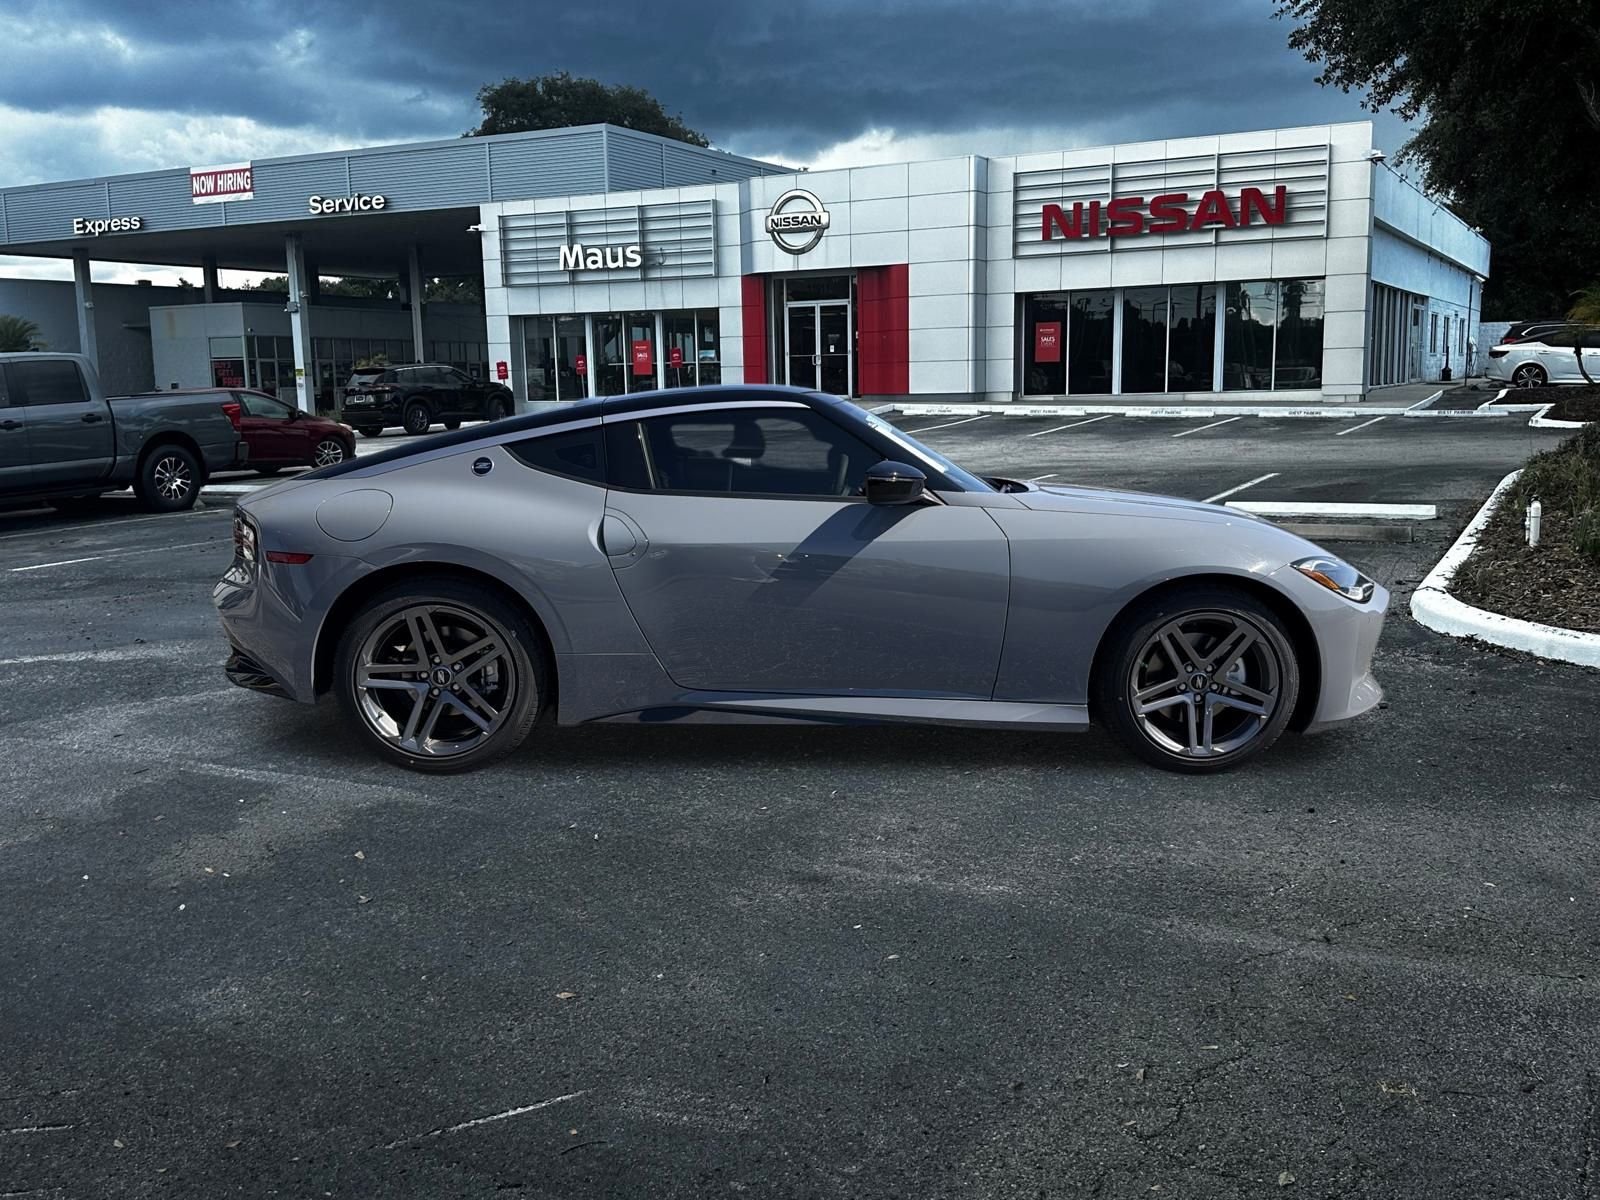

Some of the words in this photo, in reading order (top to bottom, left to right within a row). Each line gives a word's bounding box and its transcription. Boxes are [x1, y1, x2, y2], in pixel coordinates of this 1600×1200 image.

[192, 174, 215, 195] NOW
[217, 171, 251, 192] HIRING
[308, 193, 385, 214] Service
[1042, 185, 1287, 241] NISSAN
[73, 216, 141, 237] Express
[770, 214, 822, 228] NISSAN
[559, 243, 642, 271] Maus
